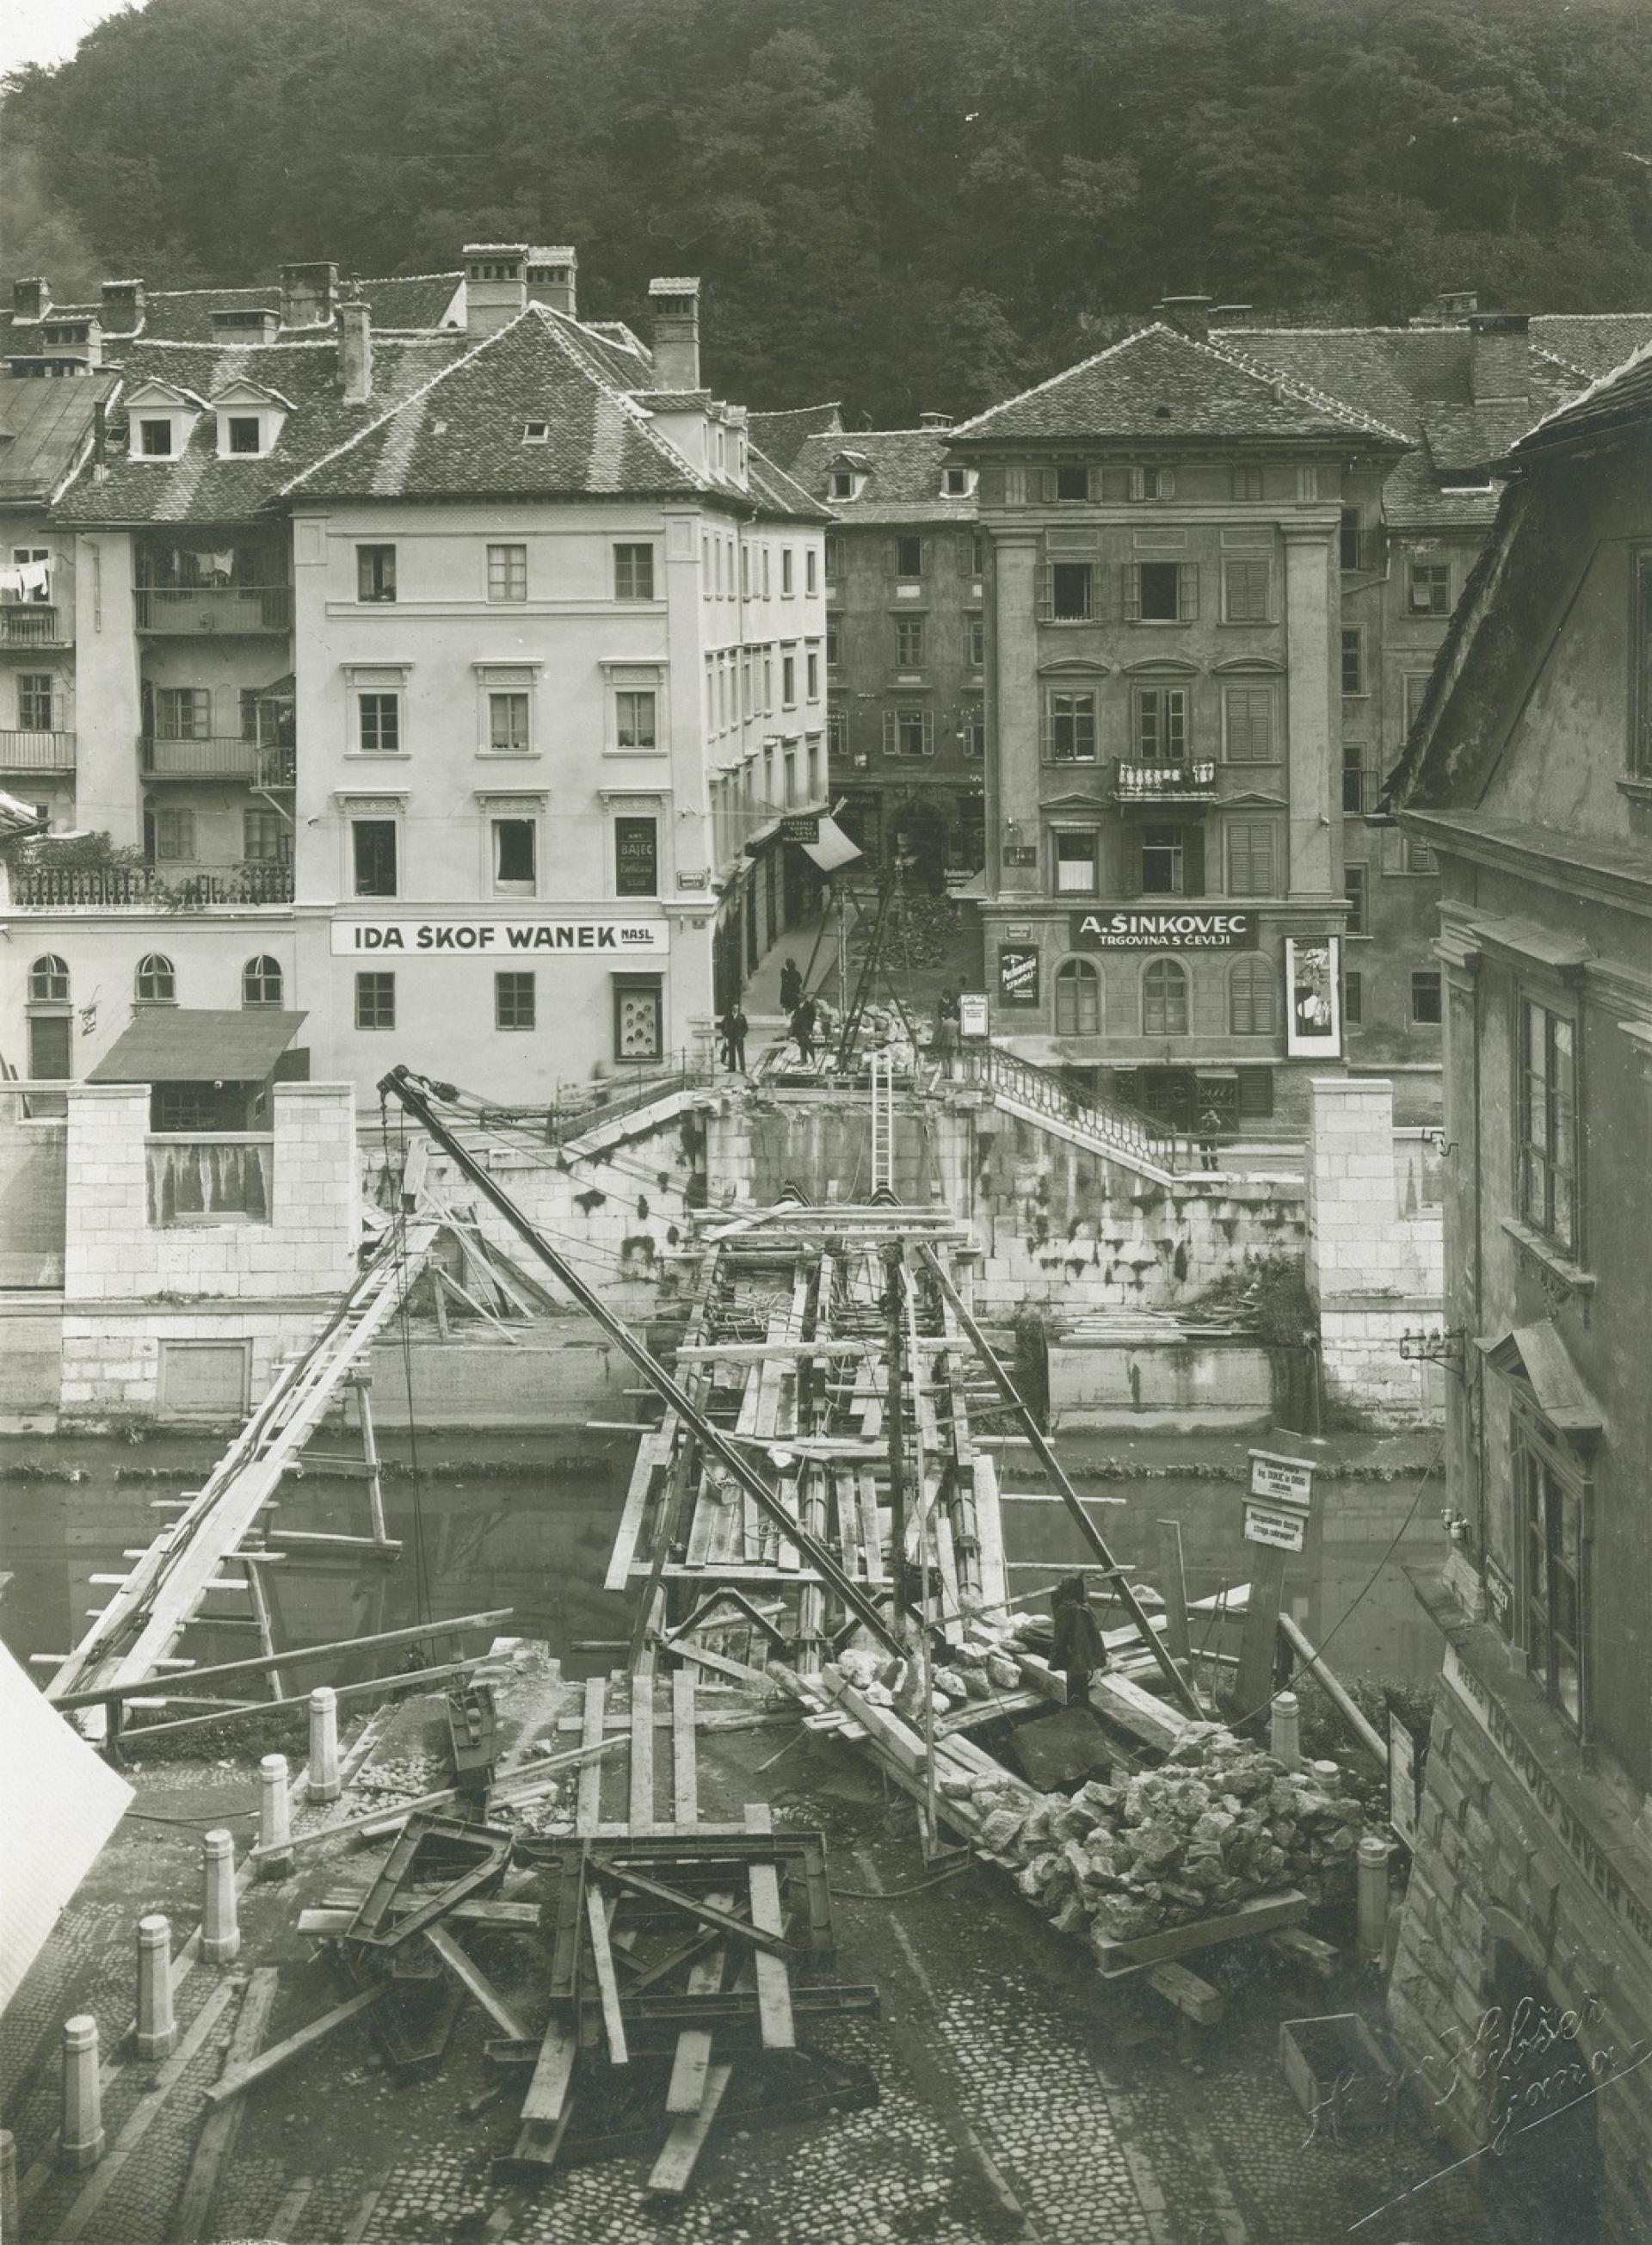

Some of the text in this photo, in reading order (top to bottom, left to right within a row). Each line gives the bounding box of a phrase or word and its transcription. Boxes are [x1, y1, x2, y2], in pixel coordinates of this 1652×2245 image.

[621, 843, 653, 857] BAJEC
[355, 927, 404, 948] IDA
[416, 925, 496, 949] ŠKOF
[506, 927, 618, 949] WANEK
[1099, 934, 1168, 946] TRGOVINA
[1184, 933, 1231, 946] ČEVLJI
